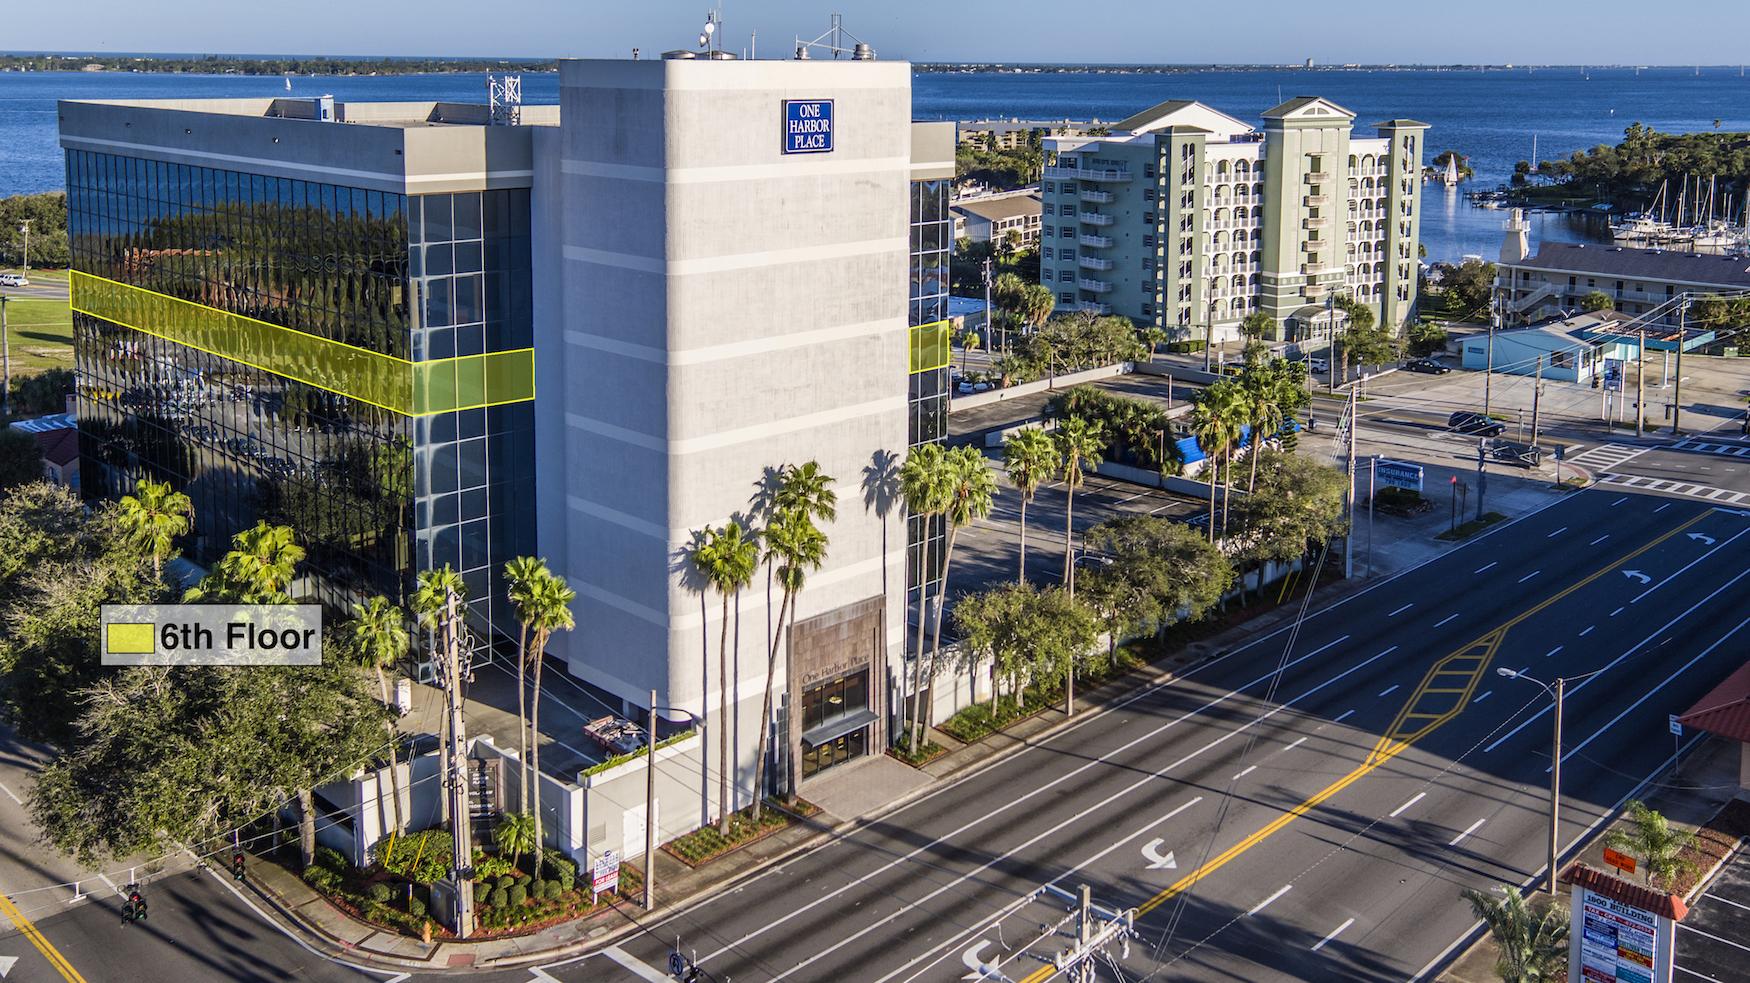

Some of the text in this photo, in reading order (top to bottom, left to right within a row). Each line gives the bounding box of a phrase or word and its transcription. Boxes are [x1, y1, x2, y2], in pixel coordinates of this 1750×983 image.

[800, 104, 821, 118] ONE
[790, 119, 830, 133] HARBOR
[794, 134, 825, 149] PLACE
[1378, 466, 1419, 481] INSURANCE
[802, 673, 819, 685] One
[821, 661, 848, 677] Harbor
[1610, 903, 1654, 925] BUILDING
